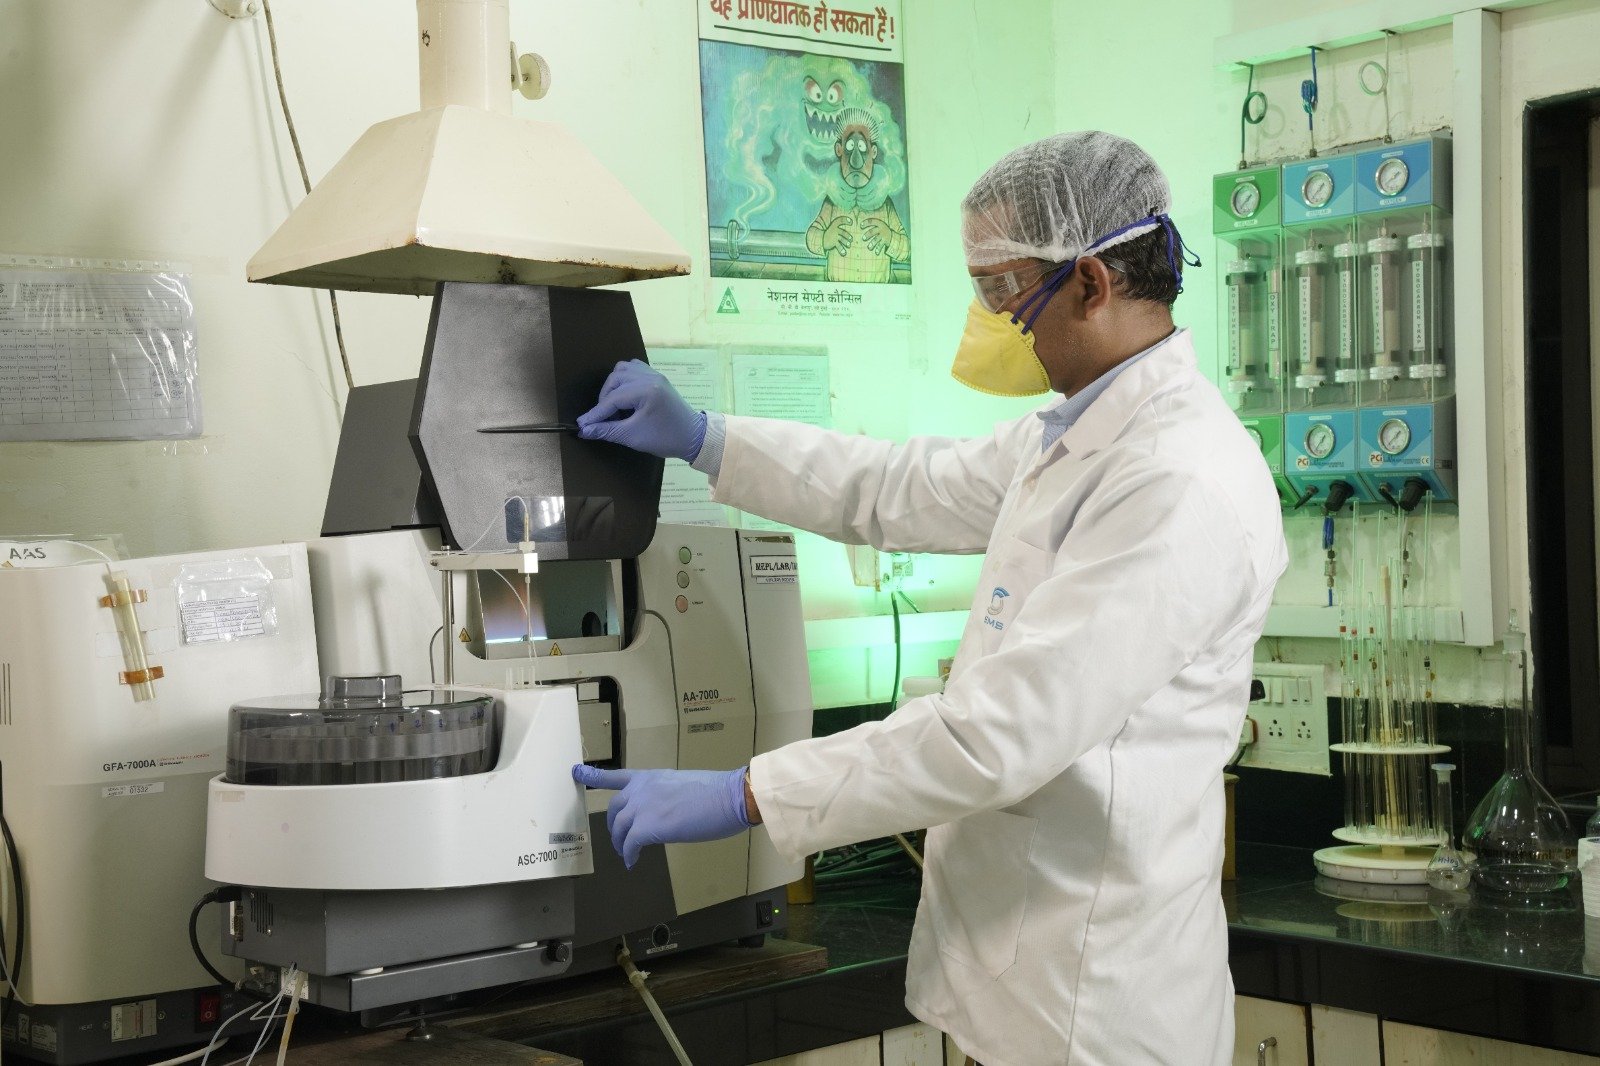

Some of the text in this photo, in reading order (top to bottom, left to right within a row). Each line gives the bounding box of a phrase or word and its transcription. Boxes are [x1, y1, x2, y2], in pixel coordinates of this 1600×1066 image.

[830, 9, 875, 36] सकता
[683, 689, 720, 703] AA-7000
[102, 759, 157, 772] GFA-7000A
[517, 849, 558, 867] ASC-7000
